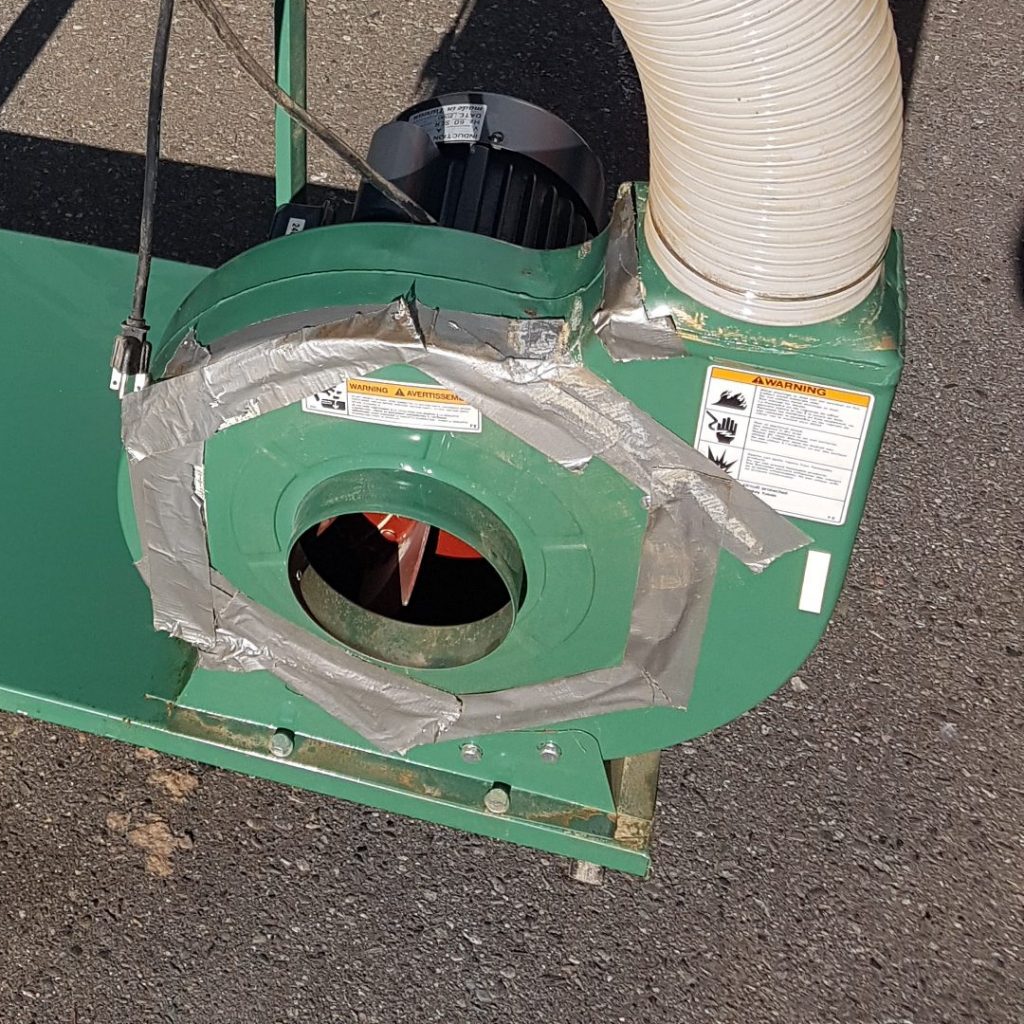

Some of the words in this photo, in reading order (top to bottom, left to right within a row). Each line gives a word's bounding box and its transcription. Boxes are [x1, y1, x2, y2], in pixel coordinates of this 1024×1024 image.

[348, 382, 389, 394] WARNING
[407, 389, 464, 401] AVERTISSEM
[764, 378, 827, 396] WARNING
